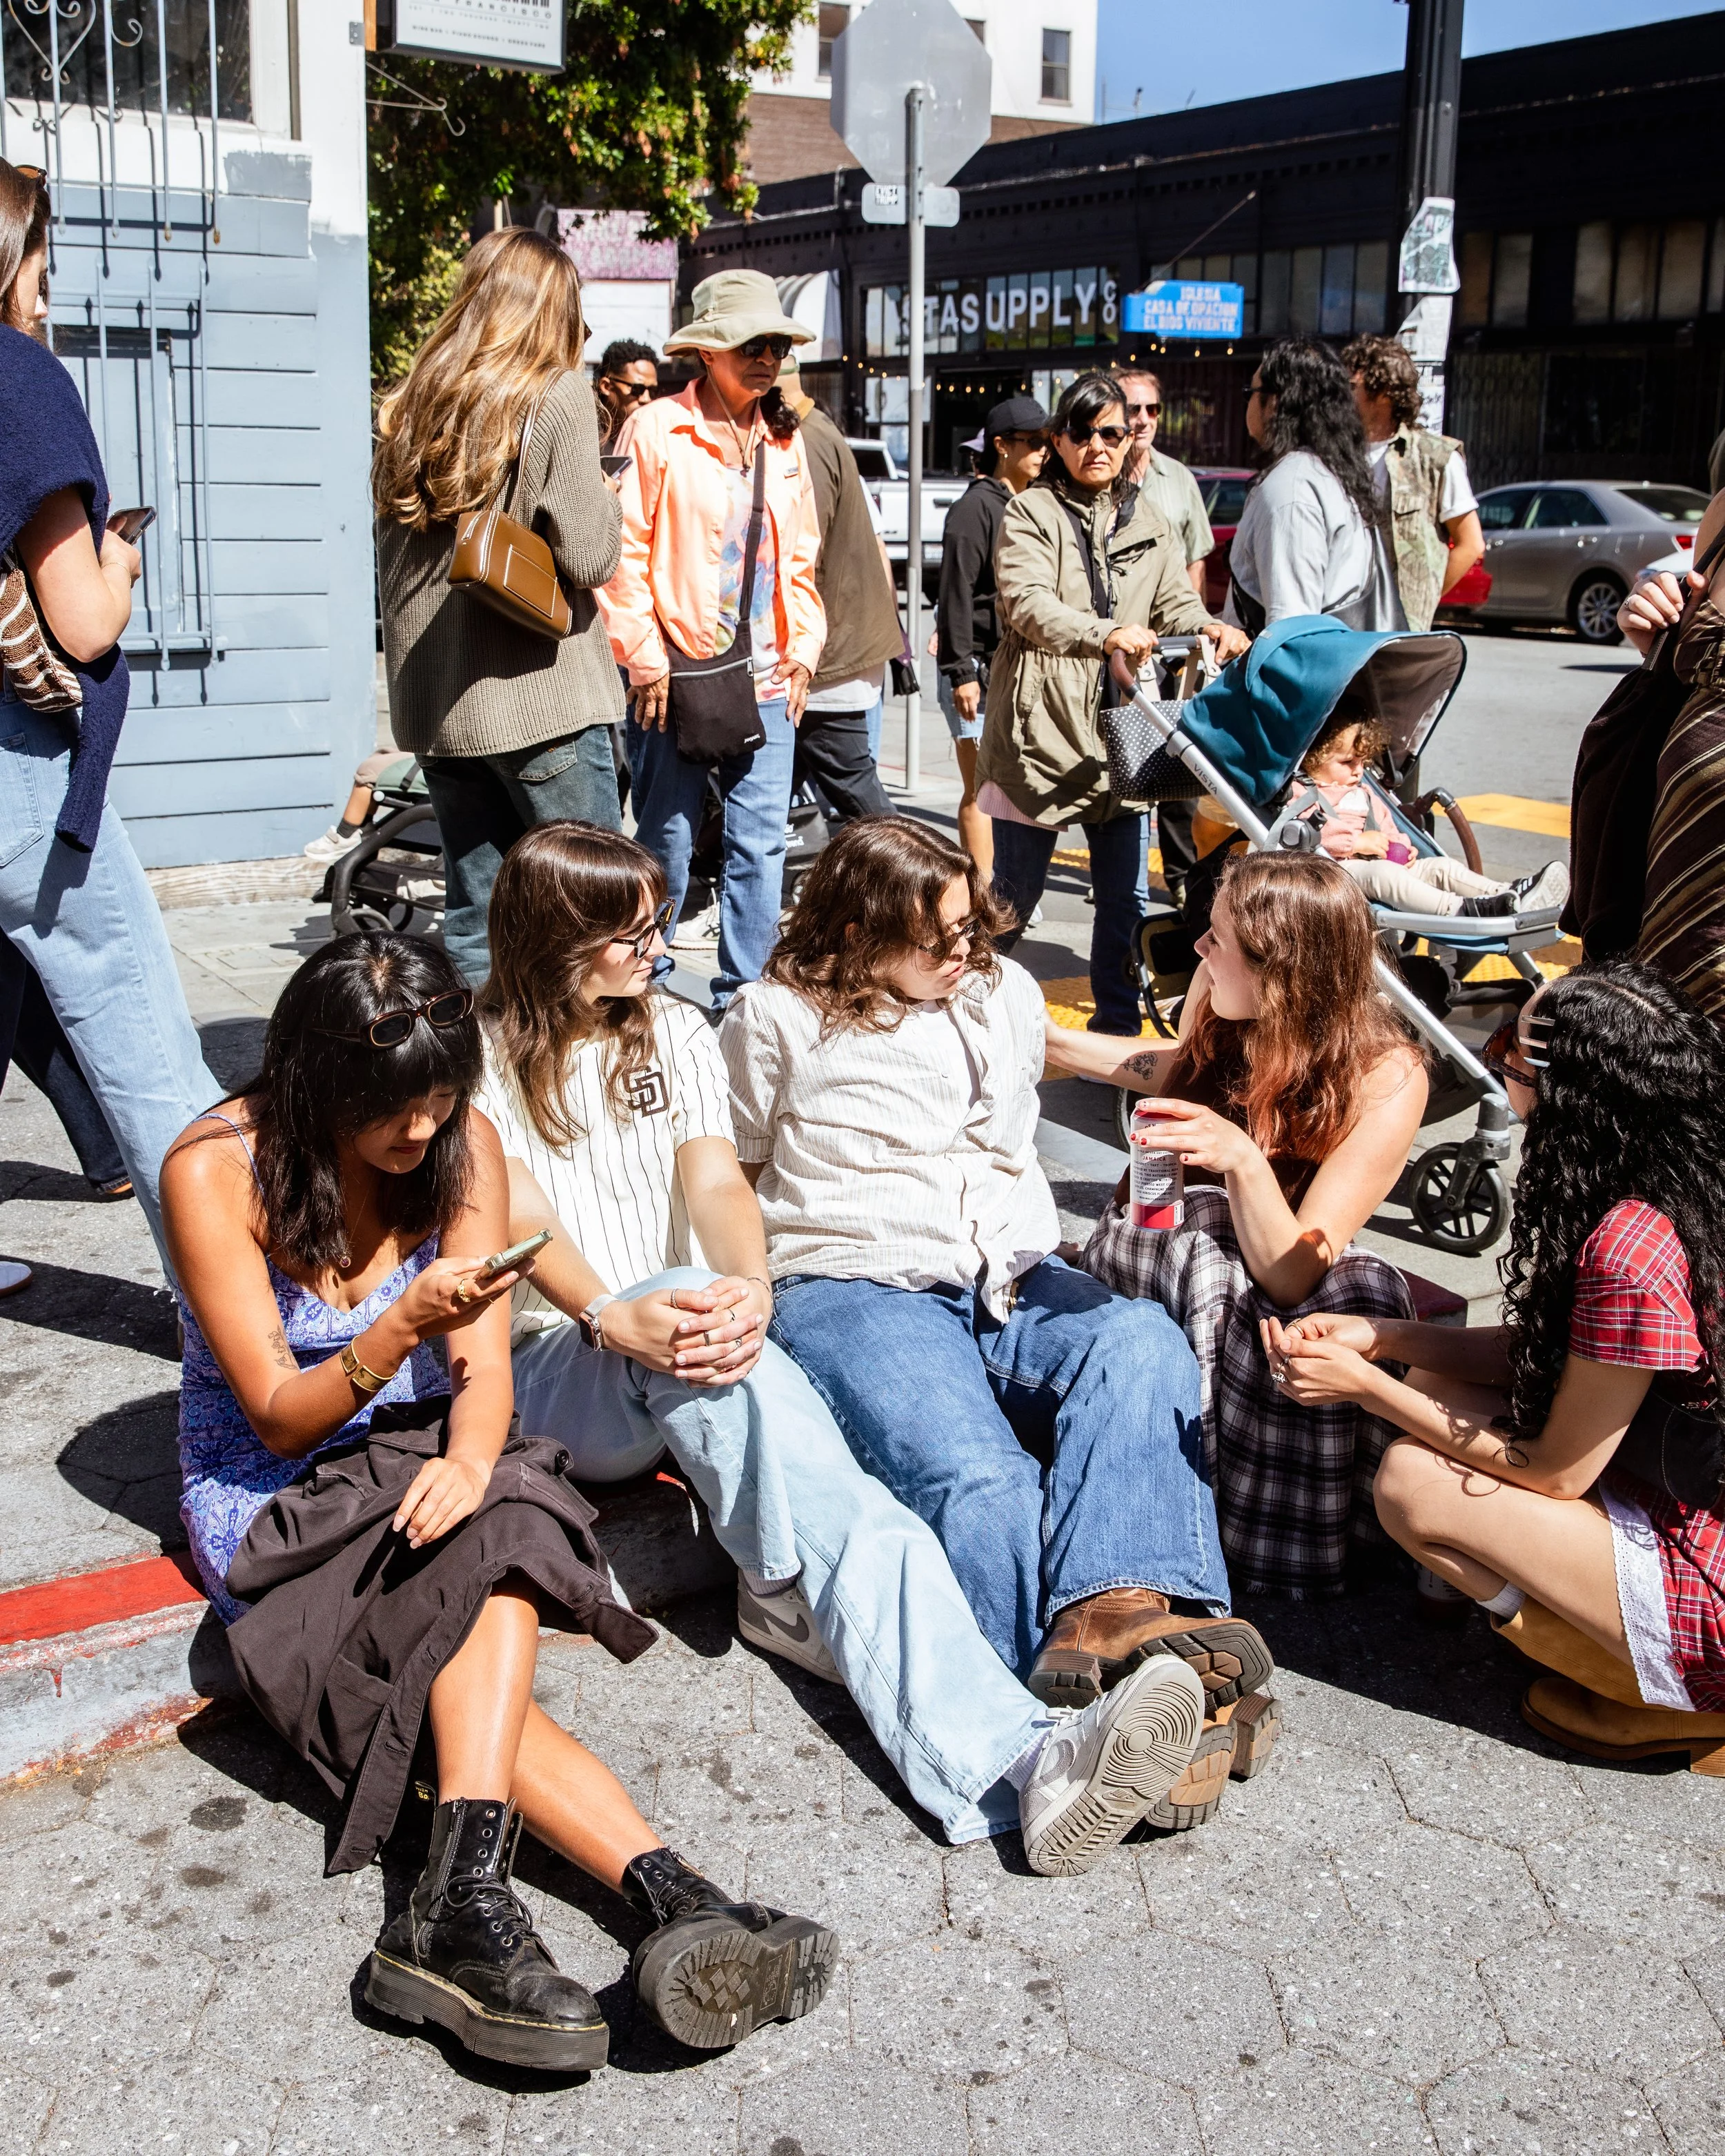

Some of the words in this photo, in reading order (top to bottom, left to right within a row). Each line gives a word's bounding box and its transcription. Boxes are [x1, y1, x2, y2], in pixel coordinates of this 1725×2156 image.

[960, 281, 1096, 334] SUPPLY
[1145, 299, 1173, 315] CASA
[1194, 763, 1217, 794] VISTA
